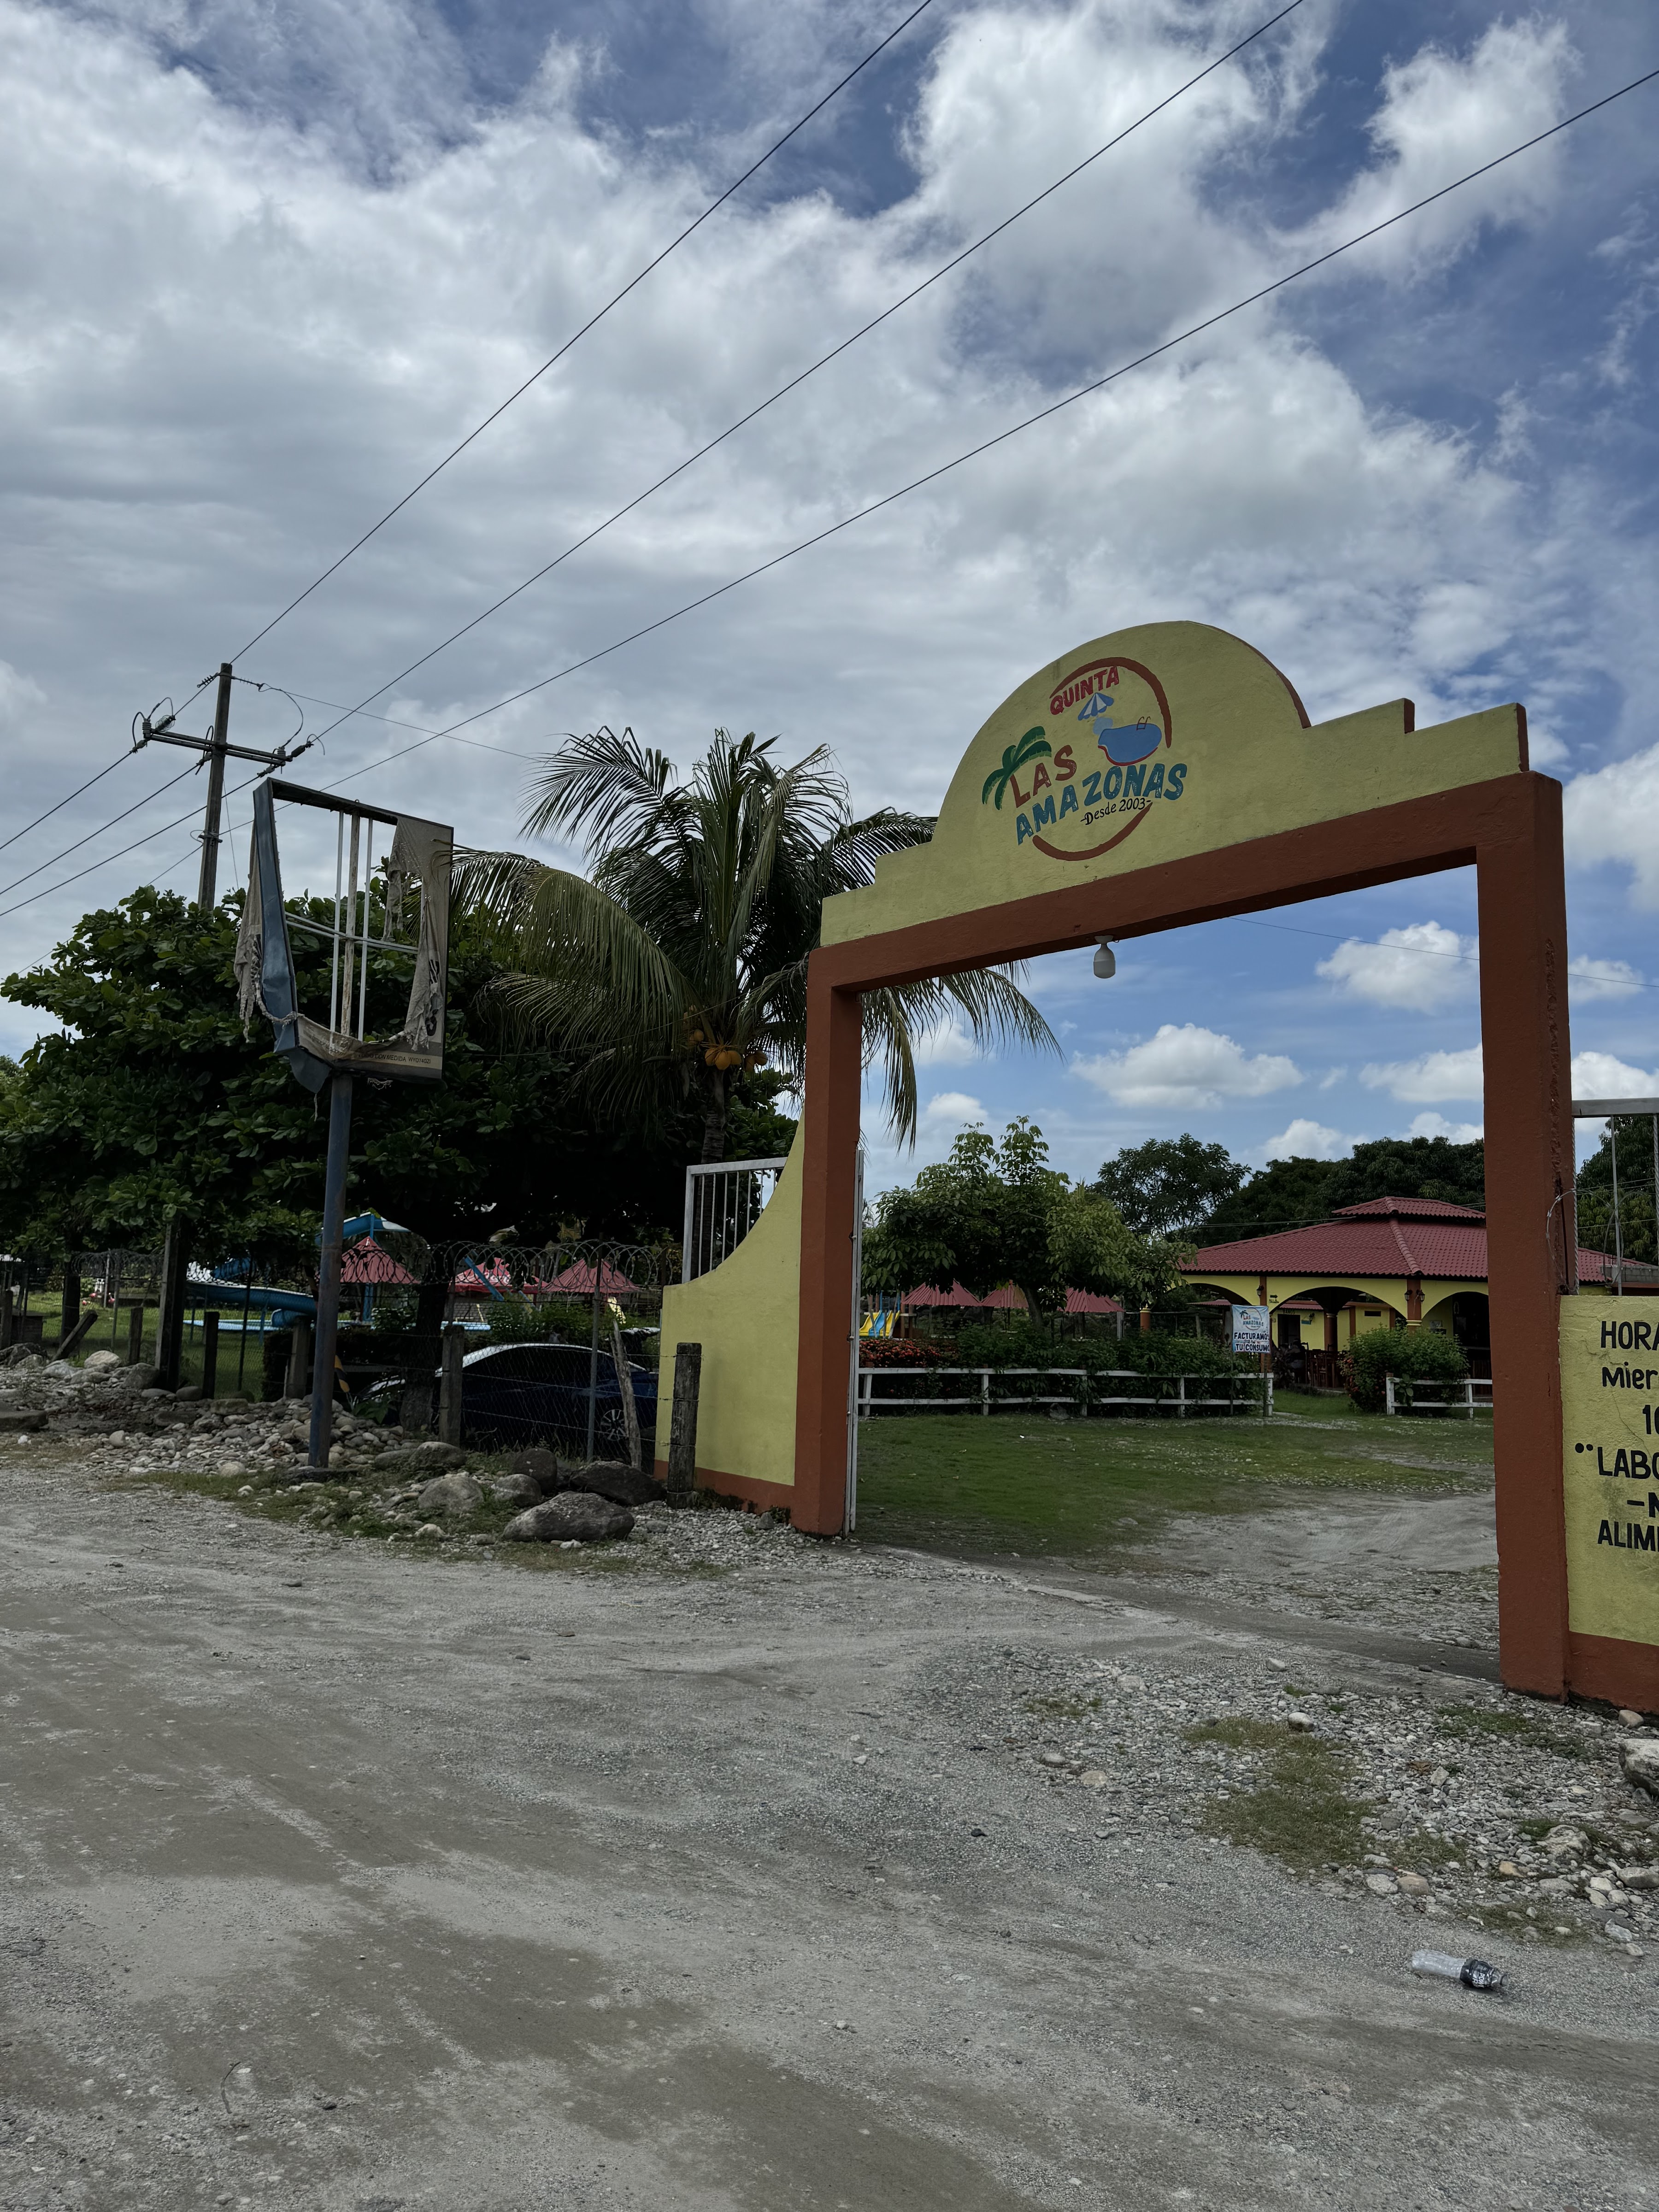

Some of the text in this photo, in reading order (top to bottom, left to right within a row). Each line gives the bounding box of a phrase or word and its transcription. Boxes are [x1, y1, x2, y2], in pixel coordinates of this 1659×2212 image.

[1049, 666, 1119, 715] QUINTA
[1009, 745, 1077, 808] LAS
[1015, 763, 1187, 845] AMAZONAS
[1602, 1361, 1659, 1389] Mier
[1598, 1519, 1659, 1552] ALIM
